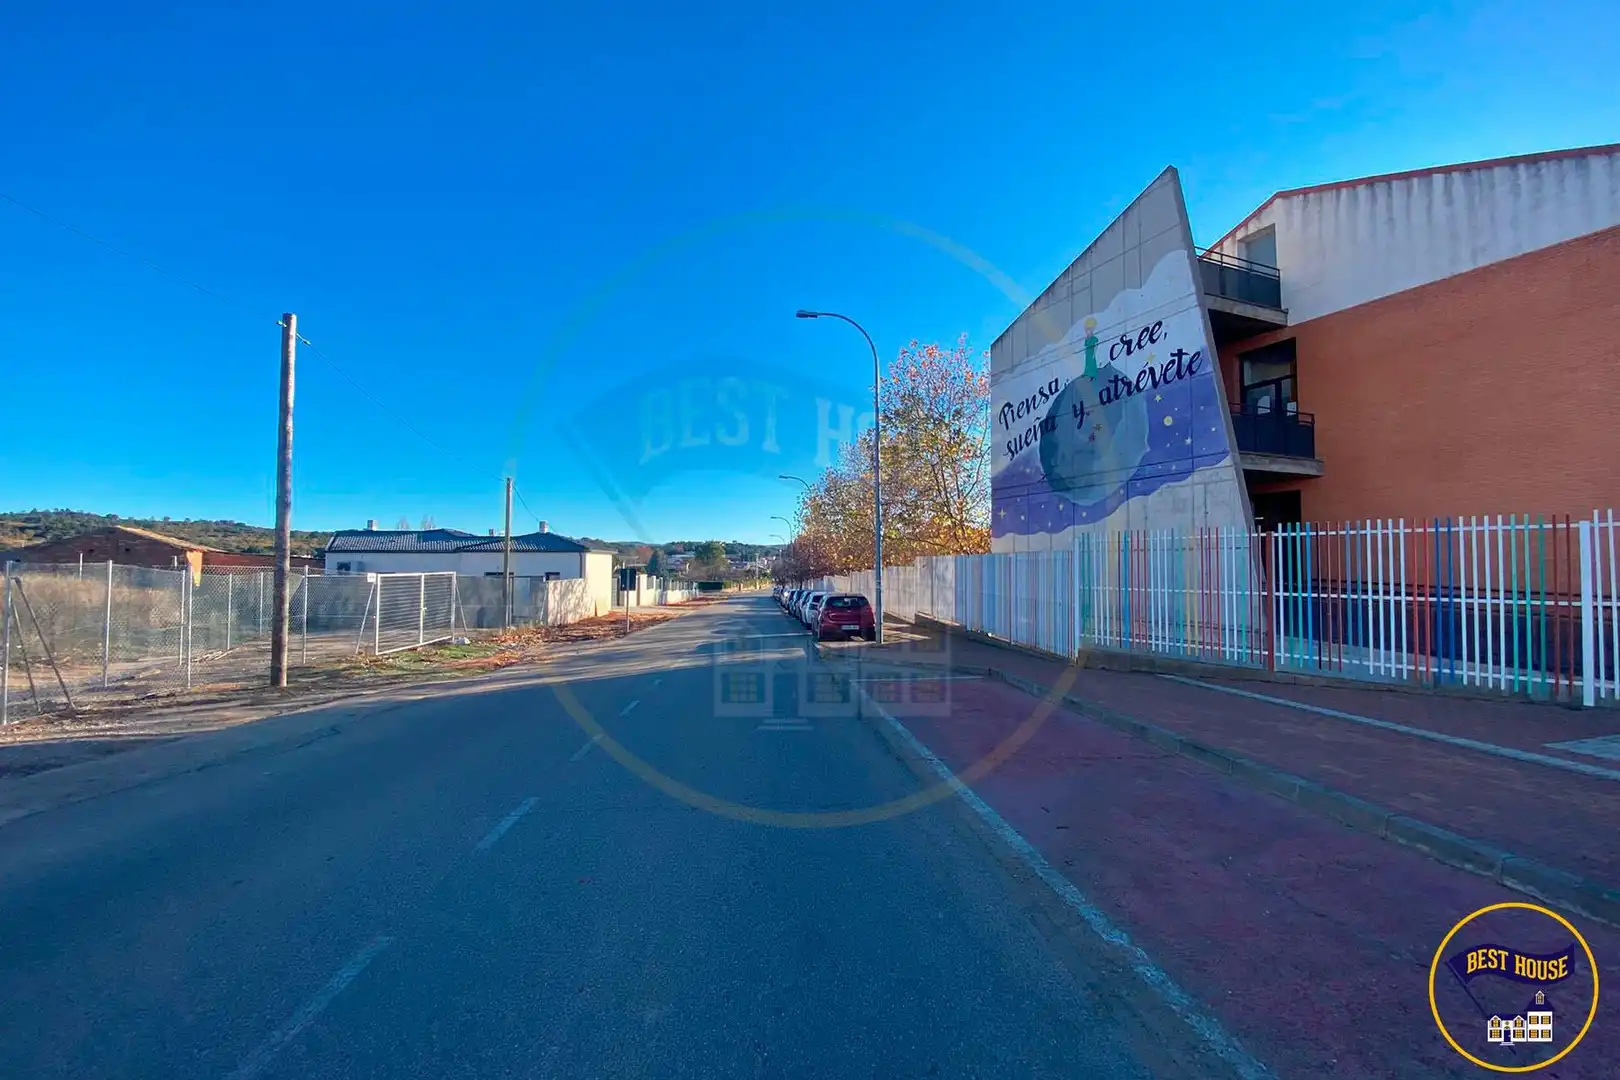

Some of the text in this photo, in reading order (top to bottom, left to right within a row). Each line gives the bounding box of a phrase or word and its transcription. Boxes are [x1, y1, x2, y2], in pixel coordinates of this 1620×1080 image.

[1109, 320, 1167, 361] cree,
[1003, 415, 1058, 461] sueña
[1072, 400, 1084, 430] y
[1099, 348, 1202, 405] atrévete
